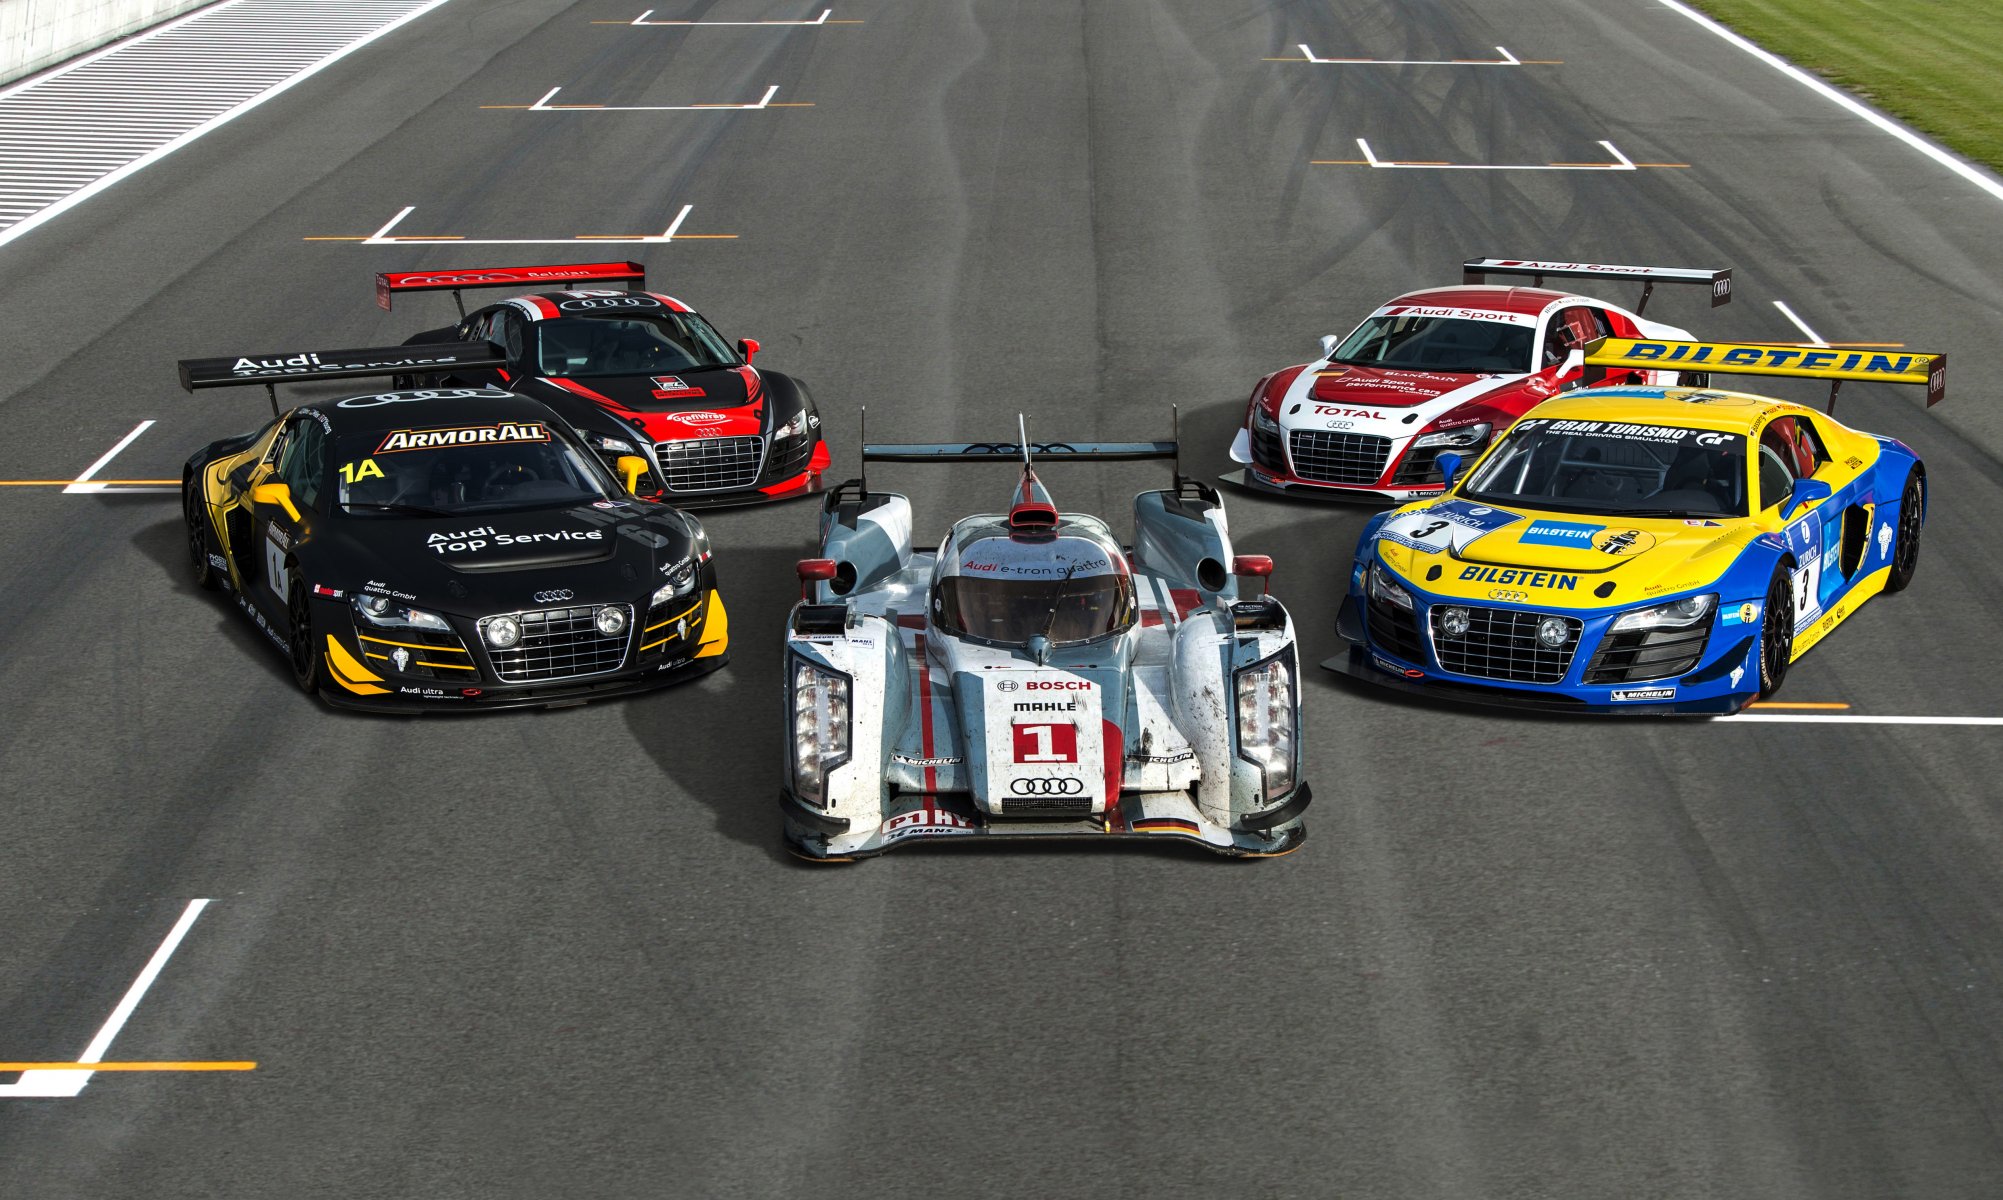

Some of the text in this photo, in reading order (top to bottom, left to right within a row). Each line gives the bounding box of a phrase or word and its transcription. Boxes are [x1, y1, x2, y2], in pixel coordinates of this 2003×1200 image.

[1527, 262, 1580, 271] Audi
[1408, 307, 1518, 322] Audi Sport
[232, 353, 321, 371] Audi
[1346, 382, 1441, 395] performance cars
[1382, 379, 1416, 387] Sport
[672, 413, 727, 422] GrafiWrap
[1314, 405, 1387, 420] TOTAL
[1549, 420, 1599, 432] GRAN
[1624, 435, 1680, 444] SIMULATOR
[338, 458, 385, 484] 1A
[427, 526, 496, 544] Audi
[1410, 521, 1450, 538] 3
[1528, 527, 1592, 539] BILSTEIN
[428, 529, 603, 554] Top Service
[963, 559, 1106, 576] Audi e-tron quattro
[366, 580, 386, 588] Audi
[1458, 565, 1579, 591] BILSTEIN
[364, 586, 417, 601] quattro GmbH
[1800, 569, 1810, 611] 3
[400, 686, 420, 694] Audi
[1026, 681, 1092, 690] BOSCH
[1627, 689, 1674, 698] MICHELIN
[1013, 702, 1077, 712] MAHLE
[1022, 725, 1068, 762] 1
[906, 757, 962, 765] MICHELIN
[881, 809, 928, 835] P1
[934, 809, 970, 828] HY
[908, 827, 954, 835] MANS
